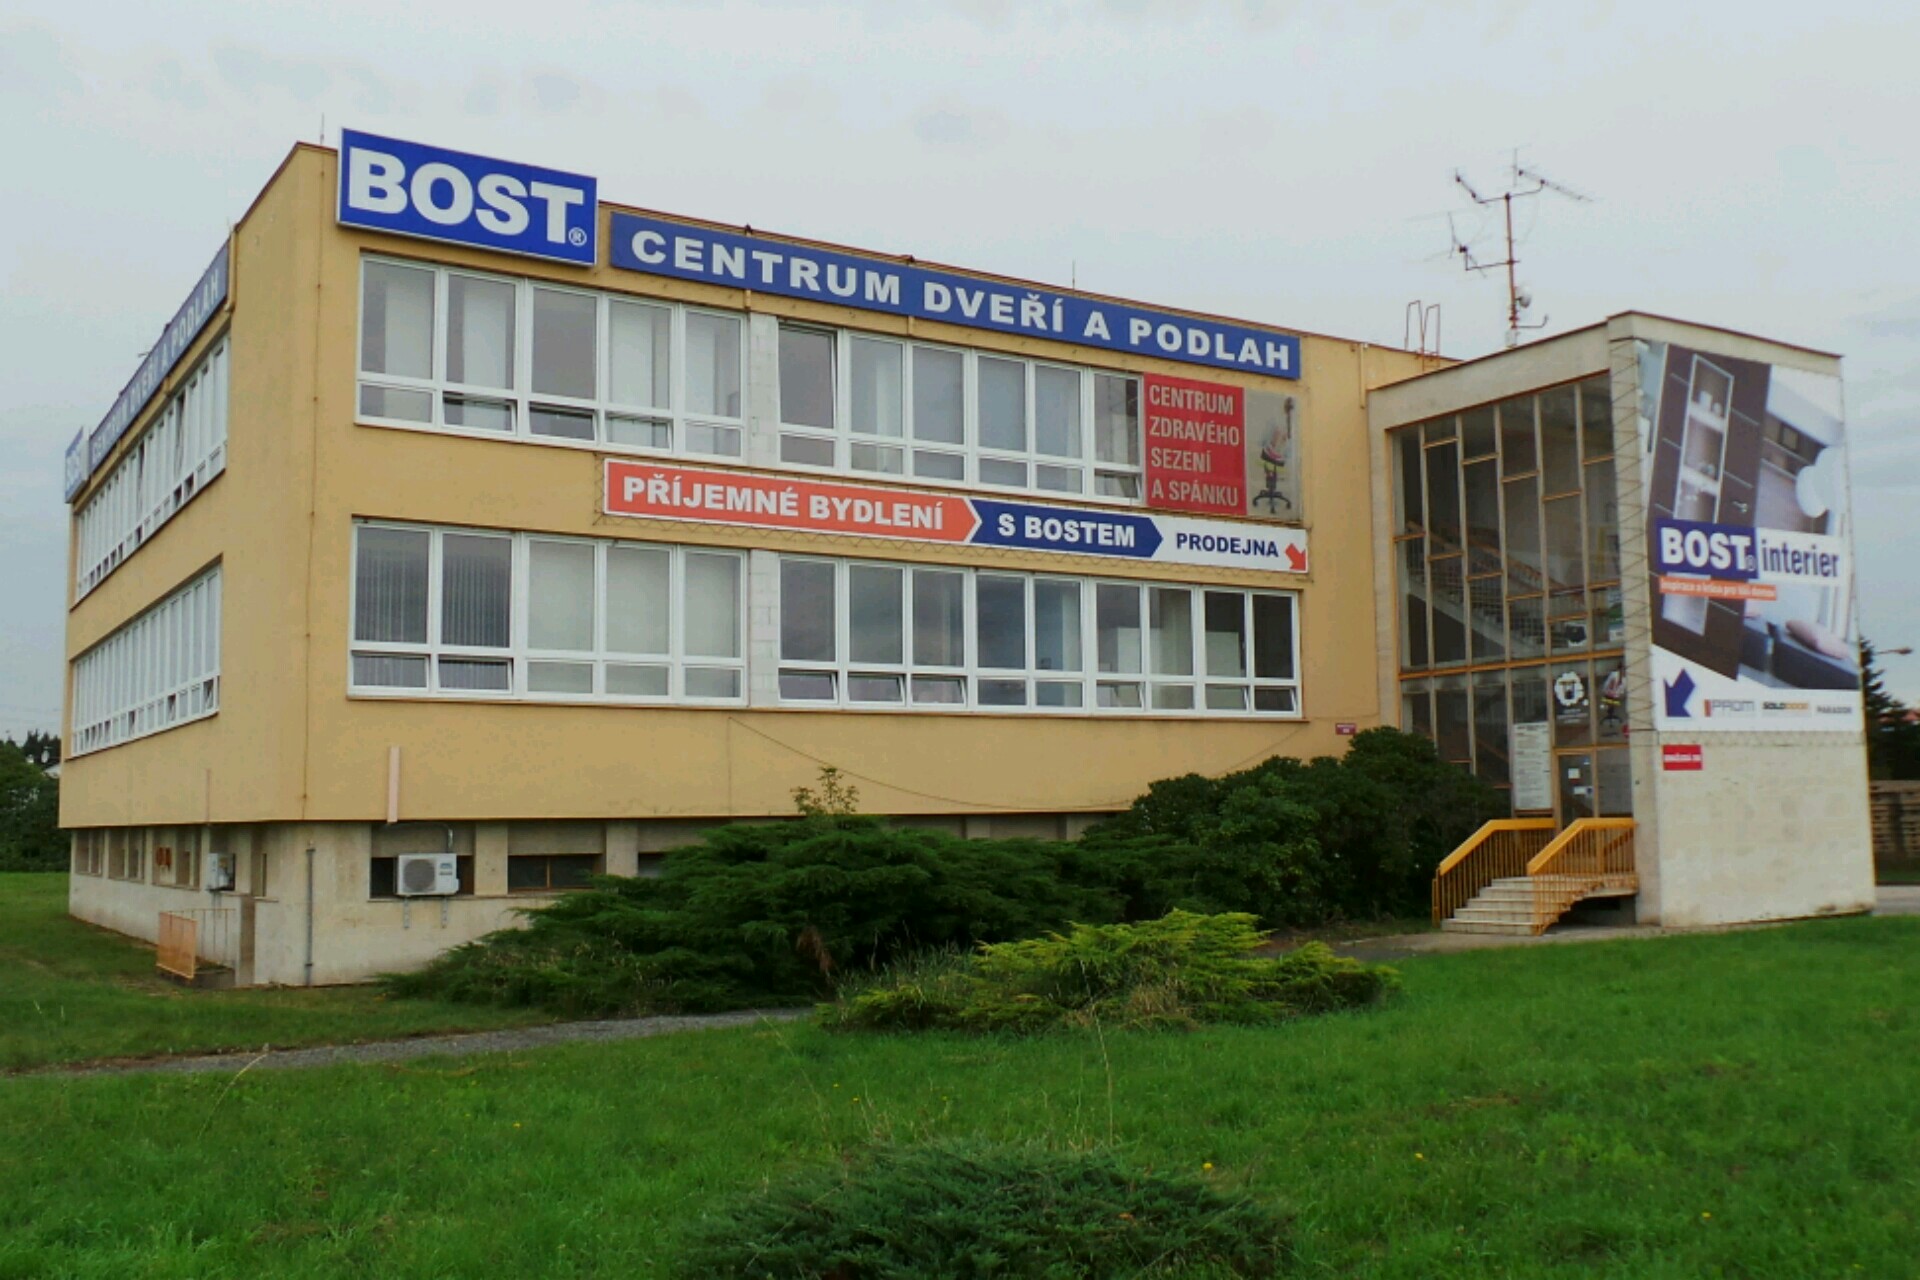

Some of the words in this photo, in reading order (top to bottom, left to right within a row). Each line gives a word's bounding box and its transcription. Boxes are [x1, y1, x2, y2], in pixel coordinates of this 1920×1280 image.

[171, 268, 220, 358] PODLAH
[631, 230, 901, 305] CENTRUM
[923, 282, 1064, 333] DVEŘÍ
[1083, 311, 1112, 340] A
[1128, 318, 1290, 370] PODLAH
[1149, 384, 1234, 415] CENTRUM
[1149, 416, 1240, 447] ZDRAVÉHO
[1150, 447, 1212, 472] SEZENÍ
[623, 474, 800, 517] PŘÍJEMNÉ
[809, 494, 943, 530] BYDLENÍ
[1151, 479, 1164, 499] A
[1168, 479, 1239, 506] SPÁNKU
[998, 513, 1016, 536] S
[1025, 516, 1136, 548] BOSTEM
[1176, 532, 1279, 558] PRODEJNA
[1761, 539, 1840, 578] interier
